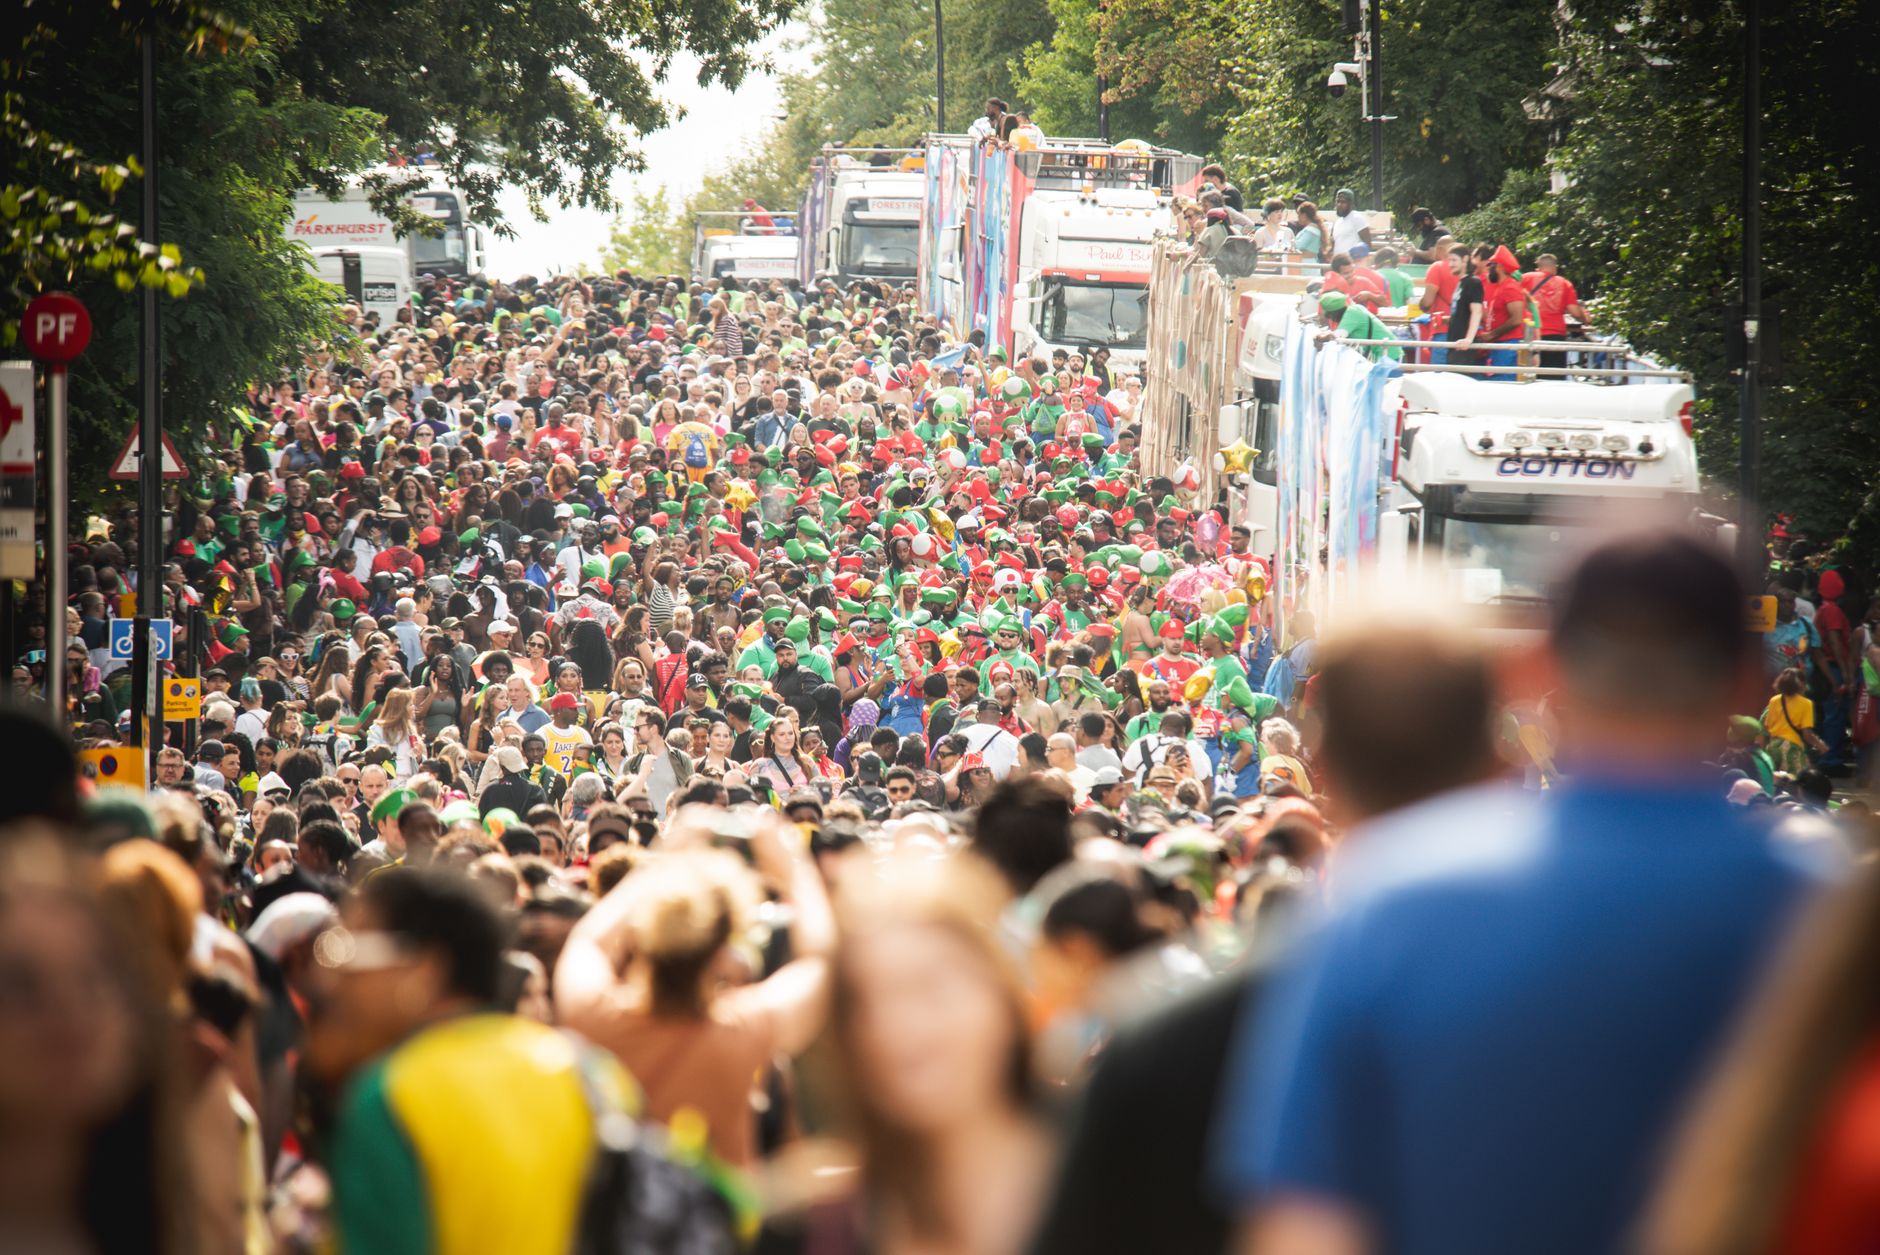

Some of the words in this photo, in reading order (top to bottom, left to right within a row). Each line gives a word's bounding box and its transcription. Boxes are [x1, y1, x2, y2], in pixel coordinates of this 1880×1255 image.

[871, 200, 906, 209] FOREST
[294, 223, 387, 235] PARKHURST
[1086, 246, 1124, 260] Paul
[738, 261, 770, 269] FOREST
[36, 313, 77, 345] PF
[1497, 457, 1636, 479] COTTON
[554, 742, 573, 753] LAKE
[561, 756, 572, 773] 2
